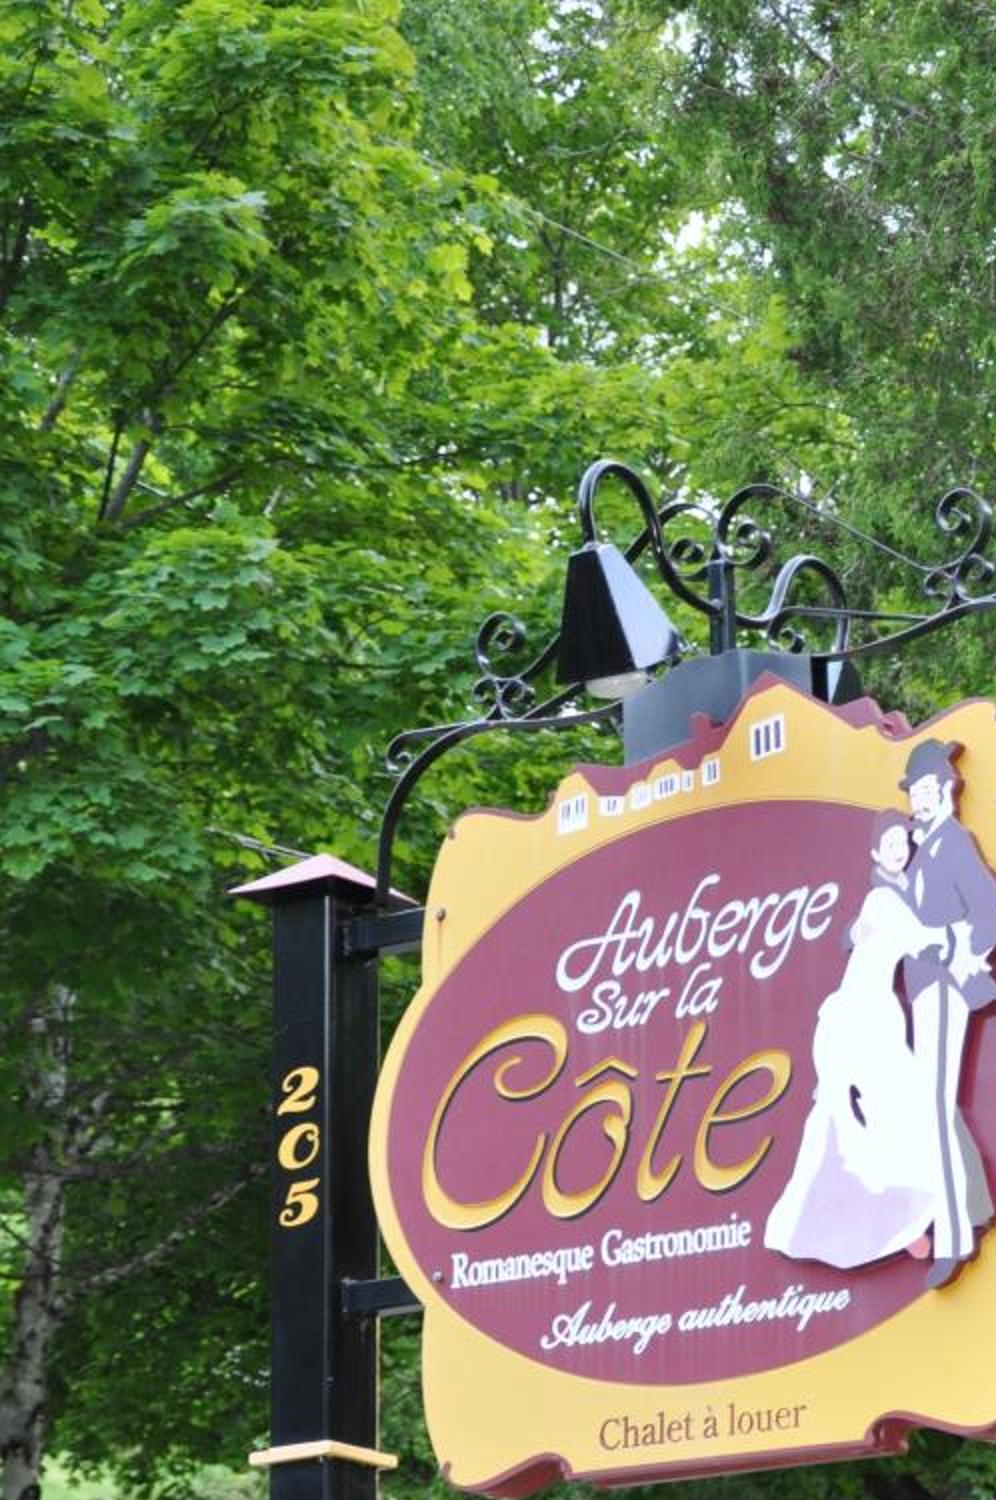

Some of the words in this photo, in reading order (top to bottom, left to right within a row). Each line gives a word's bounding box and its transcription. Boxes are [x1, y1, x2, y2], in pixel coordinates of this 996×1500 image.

[556, 873, 839, 992] Auberge
[577, 980, 671, 1034] Sur
[675, 962, 723, 1019] la
[277, 1066, 321, 1228] 205
[422, 1013, 792, 1232] Côte
[450, 1244, 594, 1289] Romanesque
[600, 1213, 752, 1268] Gastronomie
[540, 1301, 671, 1354] Auberge
[678, 1284, 851, 1331] authentique
[599, 1411, 695, 1451] Chalet
[703, 1406, 719, 1439] à
[728, 1403, 808, 1437] louer
